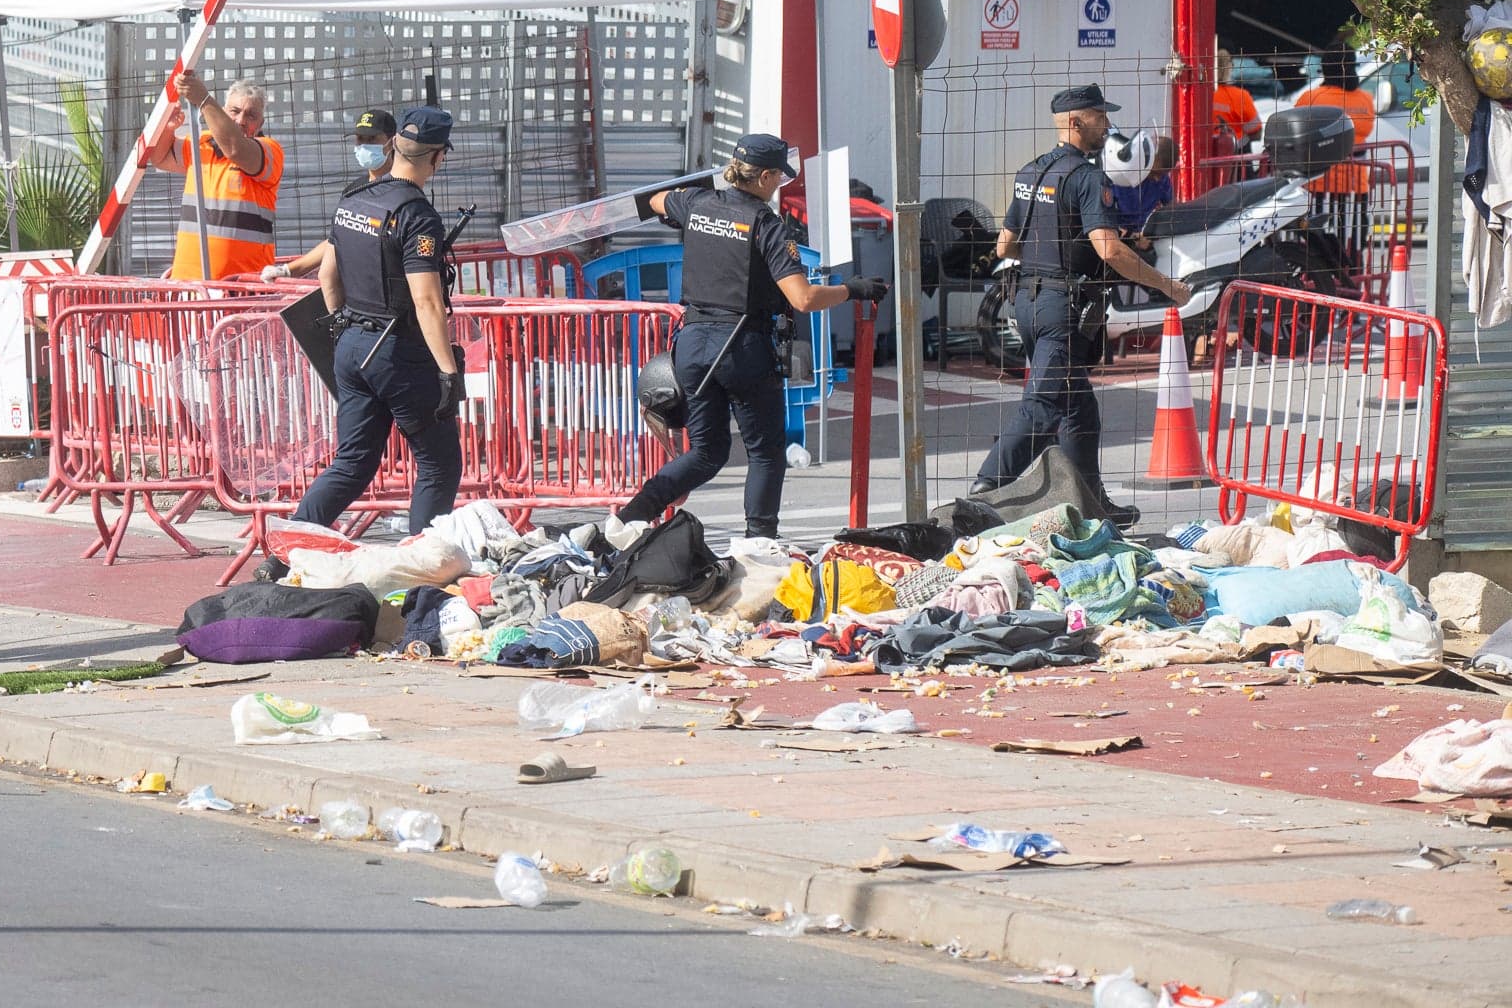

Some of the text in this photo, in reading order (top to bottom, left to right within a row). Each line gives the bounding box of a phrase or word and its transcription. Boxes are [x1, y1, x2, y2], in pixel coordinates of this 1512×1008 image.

[336, 207, 371, 226] POLICIA
[690, 213, 736, 231] POLICIA
[334, 216, 379, 237] NACIONAL
[688, 222, 748, 241] NACIONAL
